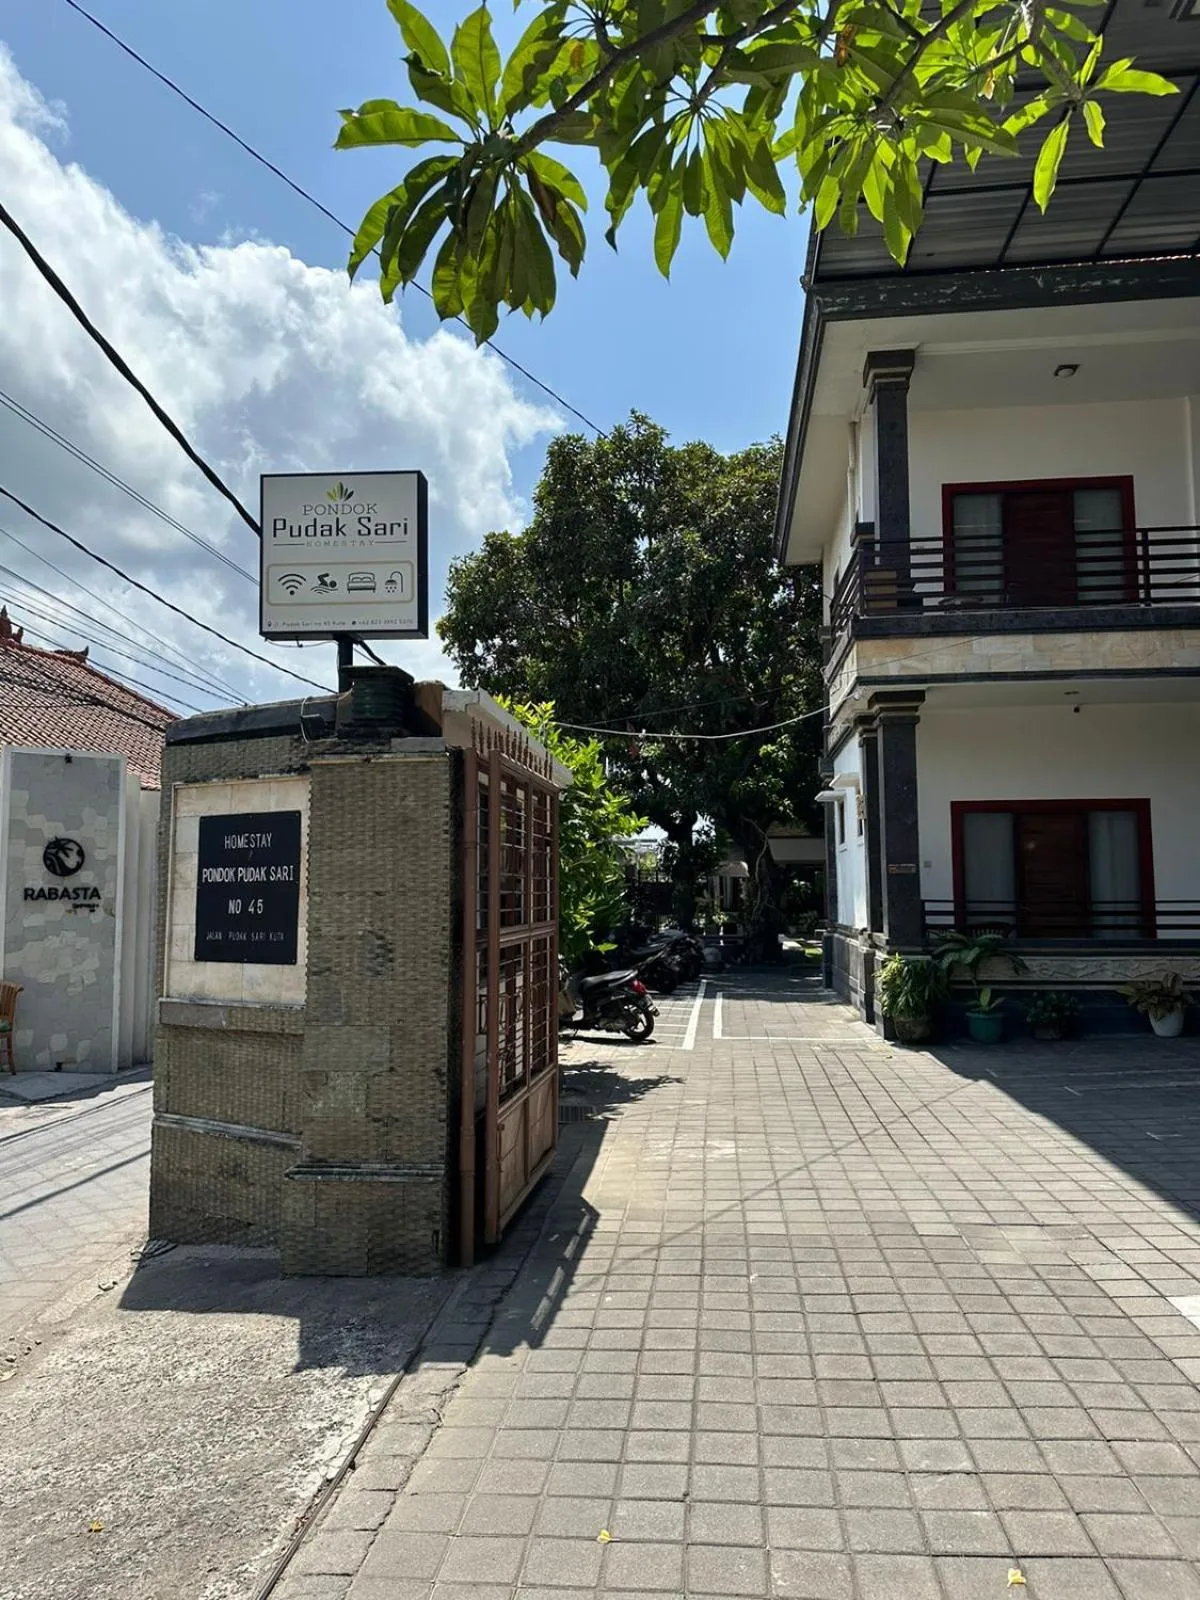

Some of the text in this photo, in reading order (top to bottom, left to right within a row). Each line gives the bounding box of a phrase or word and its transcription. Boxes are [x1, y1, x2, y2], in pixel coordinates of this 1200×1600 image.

[302, 503, 378, 516] PONDOK
[273, 516, 408, 538] Pudak Sari
[306, 540, 375, 548] HOMESTAY
[225, 833, 272, 849] HOMESTAY
[202, 865, 294, 883] PONDOK PUDAK SARI
[23, 887, 101, 901] RABASTA
[228, 899, 264, 914] NO 45
[206, 931, 222, 942] JALAN
[251, 931, 266, 942] SARI
